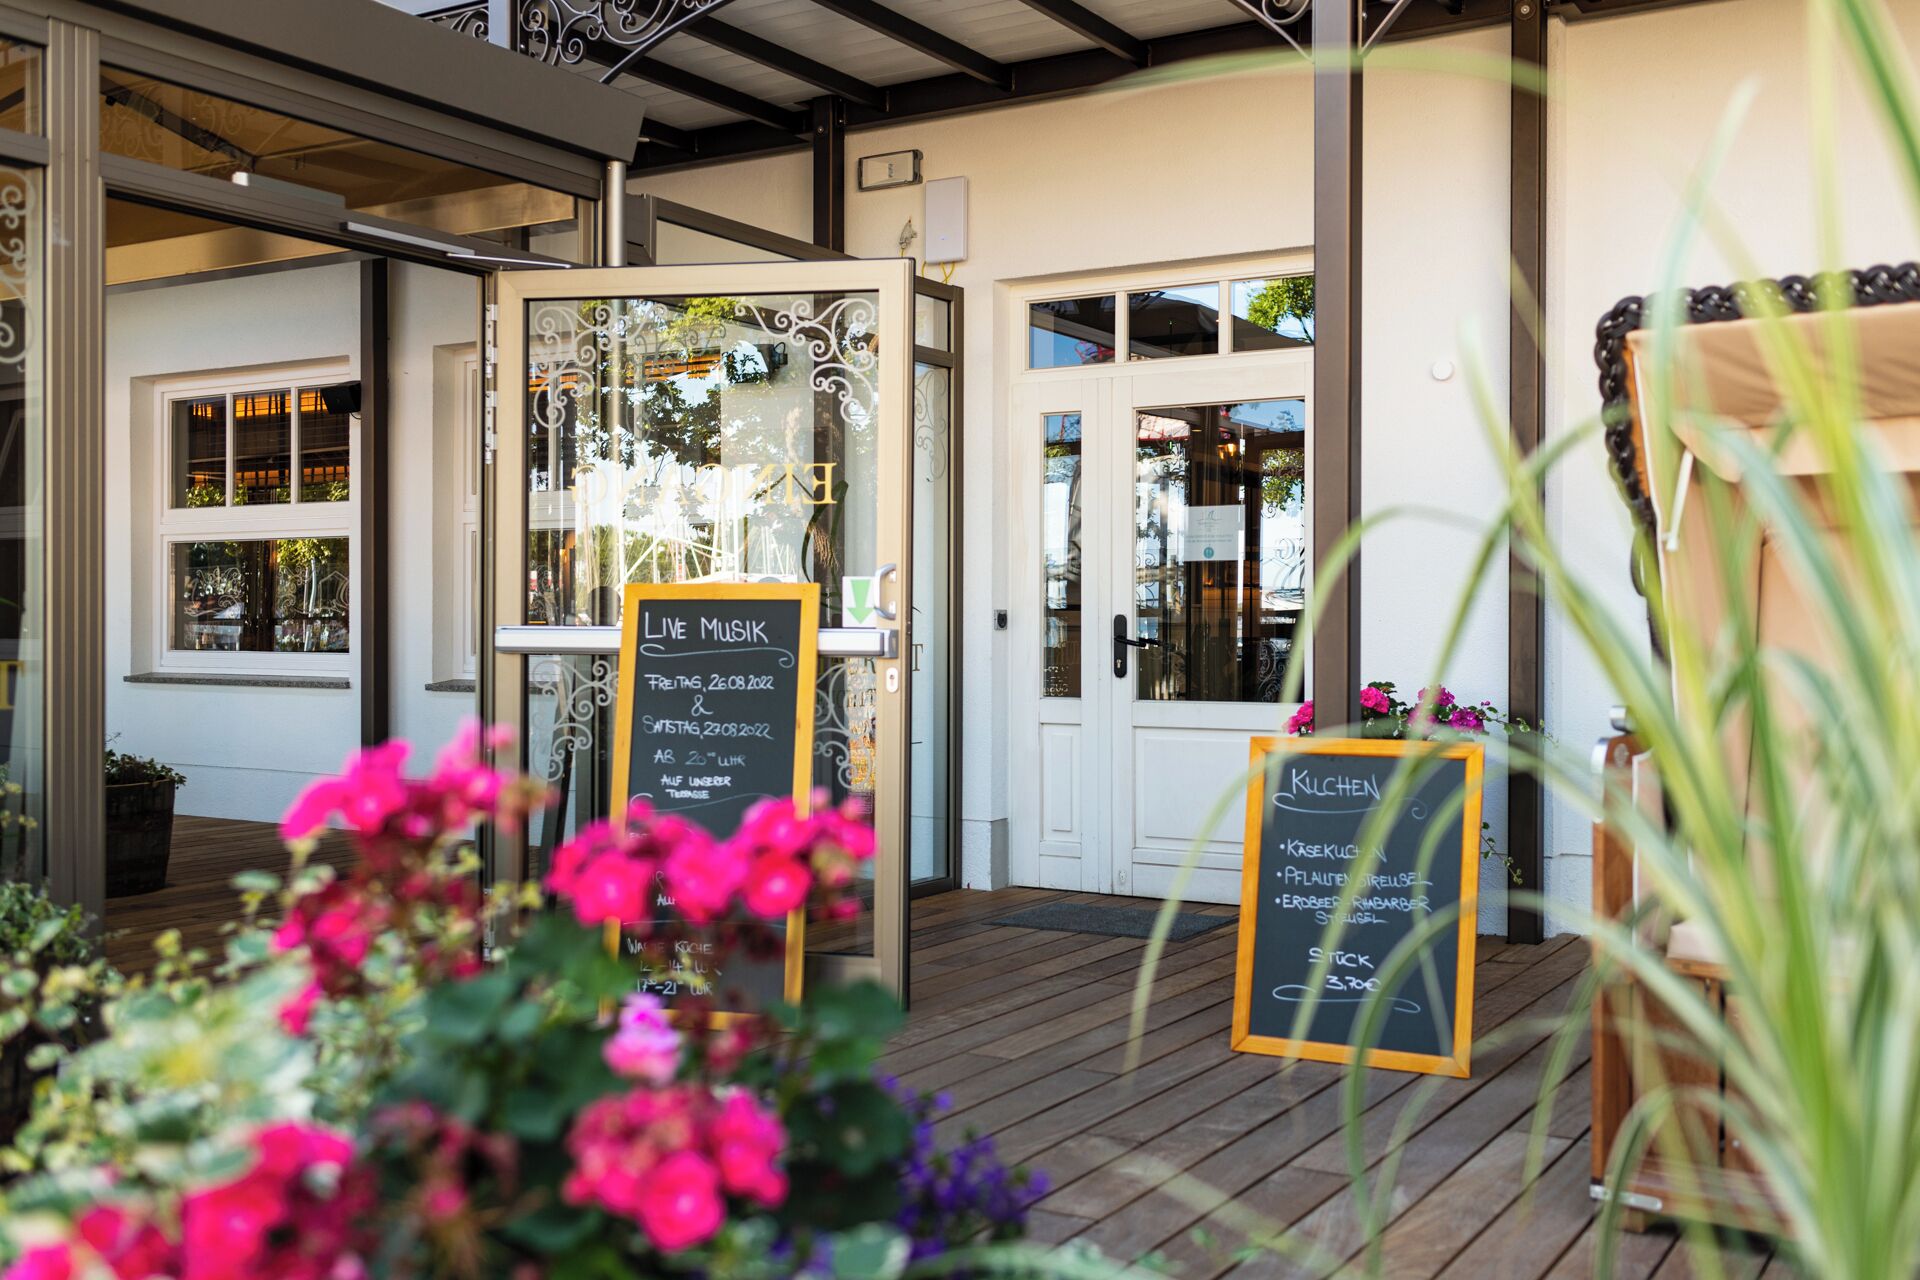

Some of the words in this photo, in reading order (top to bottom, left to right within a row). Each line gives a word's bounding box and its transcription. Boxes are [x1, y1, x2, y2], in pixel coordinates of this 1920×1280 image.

[644, 611, 688, 640] LIVE
[700, 616, 769, 644] MUSIK
[691, 694, 715, 717] &
[653, 748, 676, 765] AB
[717, 754, 747, 767] UHR
[660, 773, 684, 787] AUF
[688, 775, 732, 788] UNSERER
[1291, 768, 1381, 801] KUCHEN
[1307, 947, 1374, 970] STÜCK
